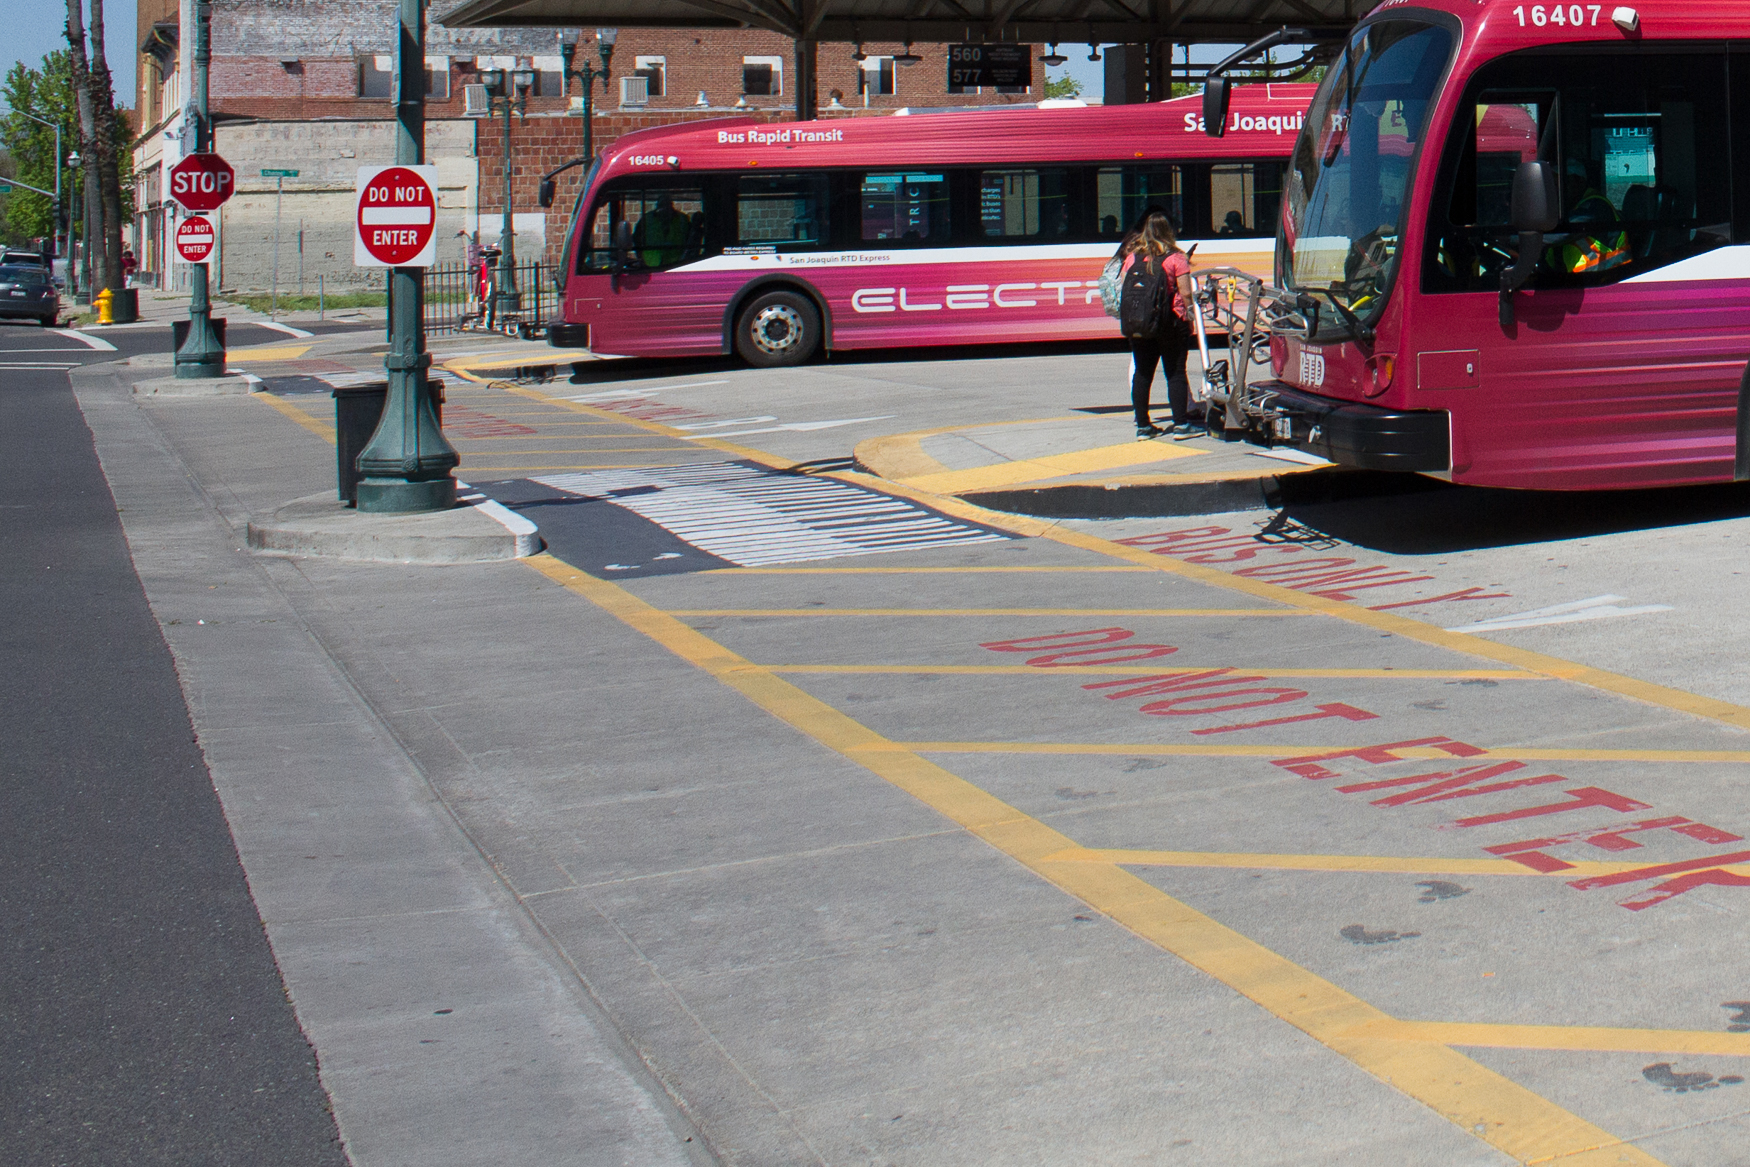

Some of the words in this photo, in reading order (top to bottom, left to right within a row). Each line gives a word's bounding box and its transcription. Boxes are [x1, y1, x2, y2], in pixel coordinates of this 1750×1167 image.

[1512, 4, 1601, 26] 16407
[953, 48, 980, 61] 560
[953, 69, 981, 82] 577
[1229, 111, 1306, 135] Joaqui
[718, 131, 745, 143] Bus
[748, 130, 791, 145] Rapid
[793, 129, 843, 141] Transit
[628, 156, 664, 166] 16405
[174, 172, 231, 193] STOP
[369, 187, 389, 202] DO
[395, 186, 425, 202] NOT
[181, 225, 192, 233] DO
[195, 224, 210, 233] NOT
[373, 230, 418, 245] ENTER
[183, 245, 207, 254] ENTER
[790, 256, 804, 264] San
[806, 256, 839, 264] Joaquin
[841, 254, 857, 262] RTD
[859, 254, 891, 263] Express
[852, 281, 1100, 312] ELECT
[1300, 351, 1325, 388] RTD
[1110, 525, 1304, 564] BUS
[1232, 557, 1512, 610] ONLY
[979, 627, 1179, 667] DO
[1081, 667, 1381, 735] NOT
